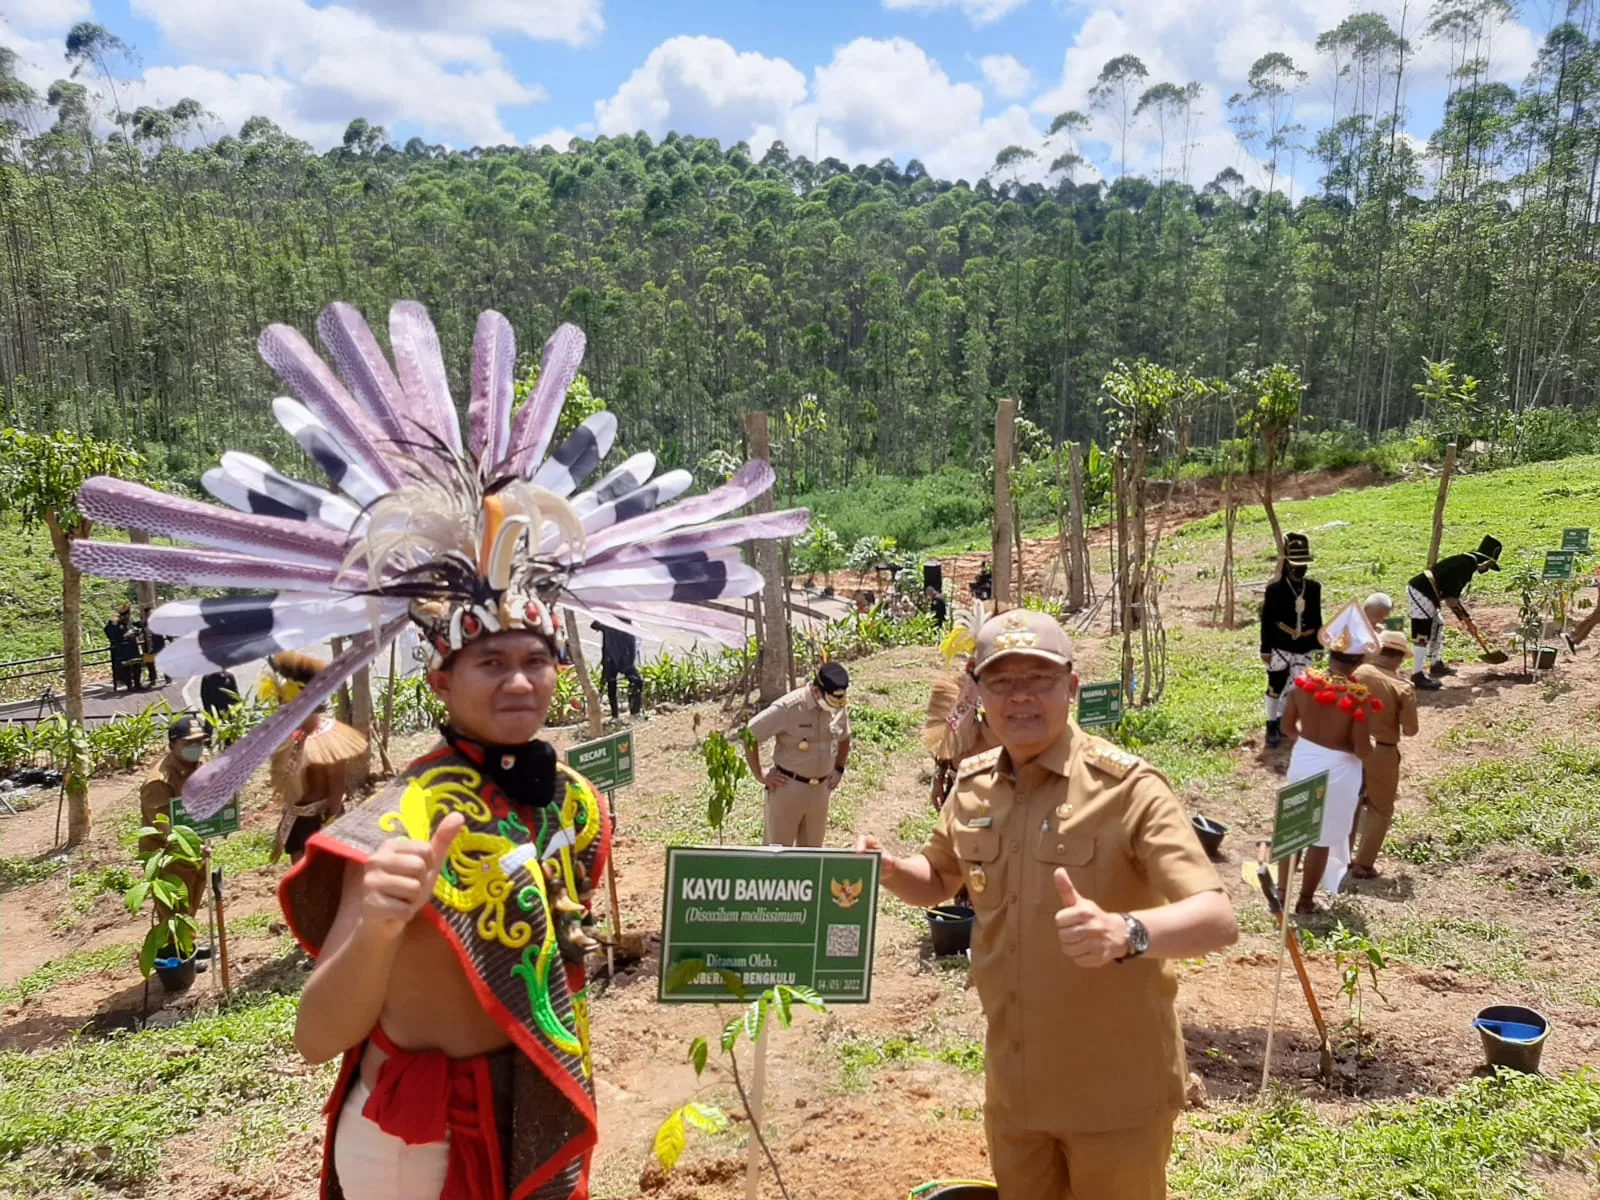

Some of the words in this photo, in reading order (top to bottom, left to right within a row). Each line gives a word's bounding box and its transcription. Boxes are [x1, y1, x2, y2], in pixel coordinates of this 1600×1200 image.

[682, 877, 730, 901] KAYU
[734, 878, 813, 902] BAWANG
[740, 908, 807, 925] mollissimum)
[706, 953, 747, 968] Ditanam
[743, 972, 796, 985] BENGKULU
